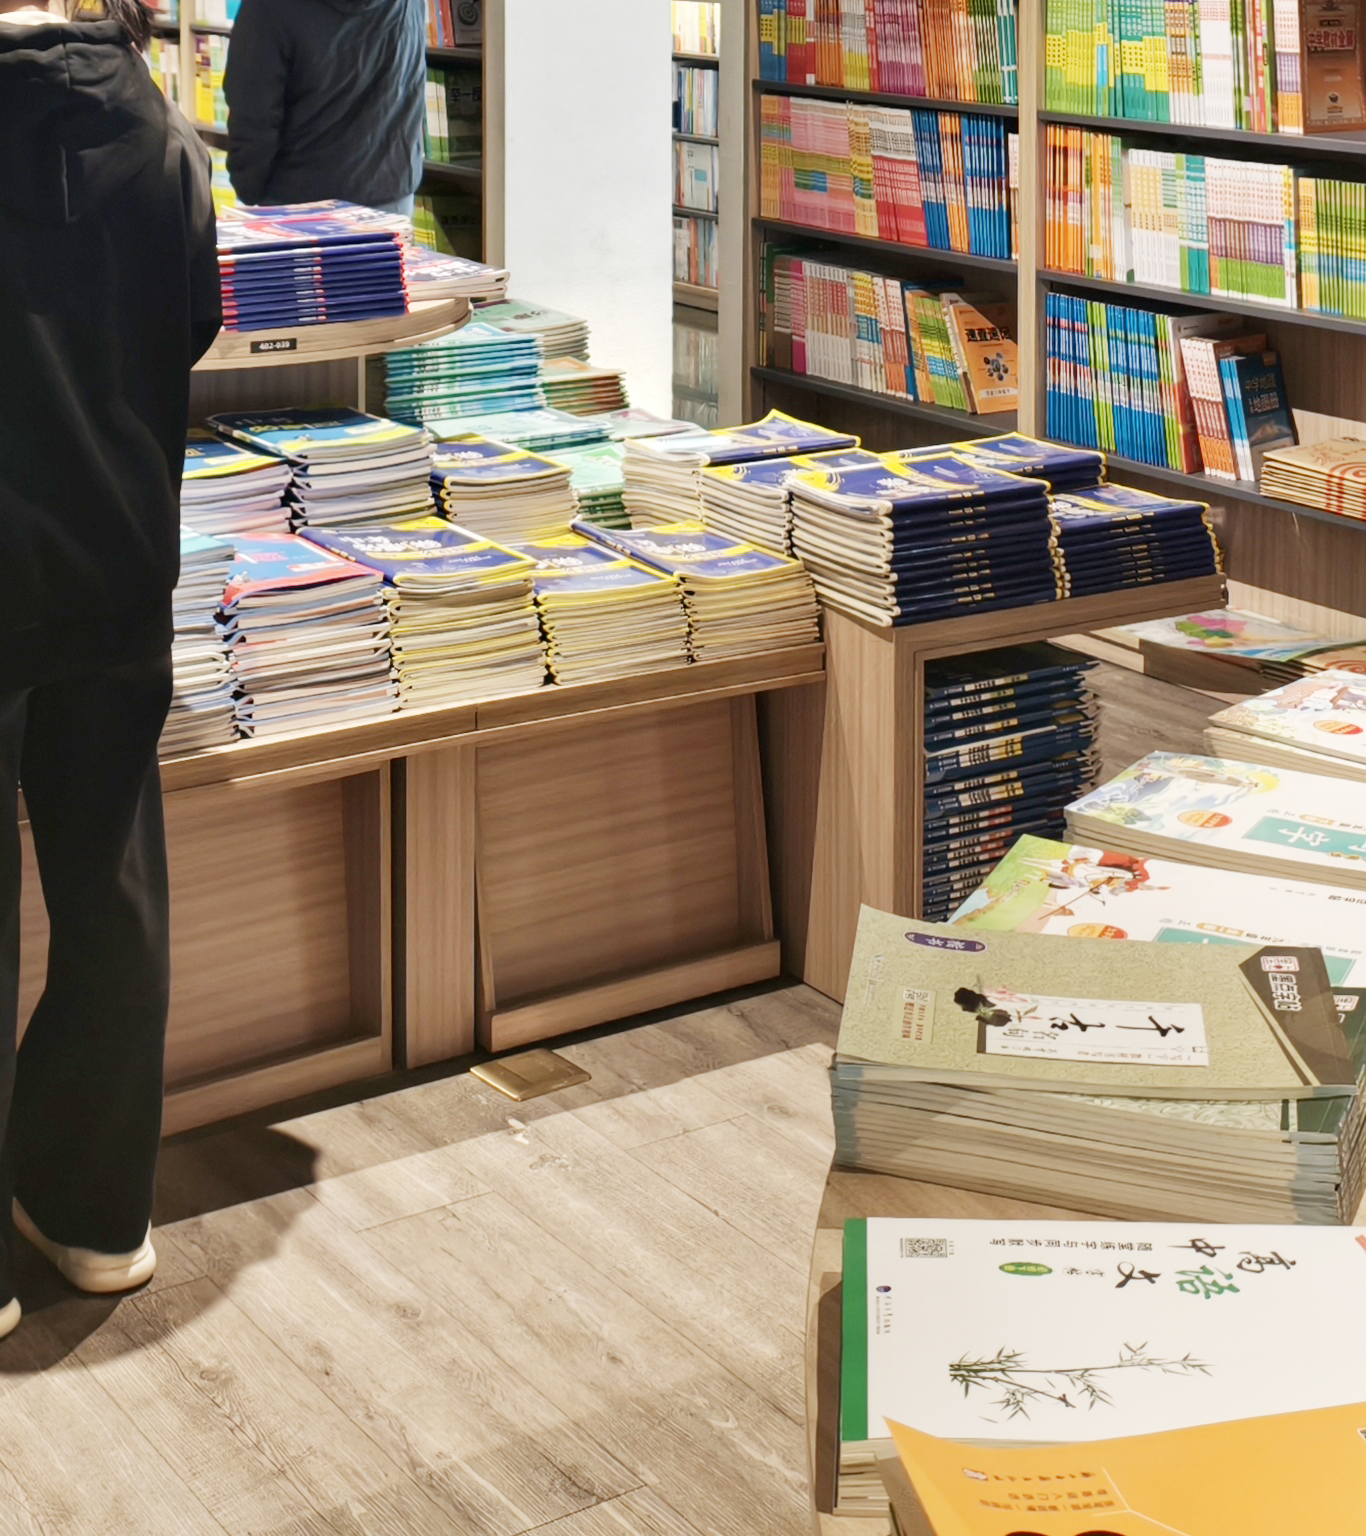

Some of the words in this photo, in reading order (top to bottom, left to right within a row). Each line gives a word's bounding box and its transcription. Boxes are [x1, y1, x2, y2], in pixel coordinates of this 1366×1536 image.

[1268, 973, 1301, 1011] 墨点字帖
[1050, 1012, 1185, 1037] 千古
[989, 1237, 1153, 1252] 随堂练字与同步默写
